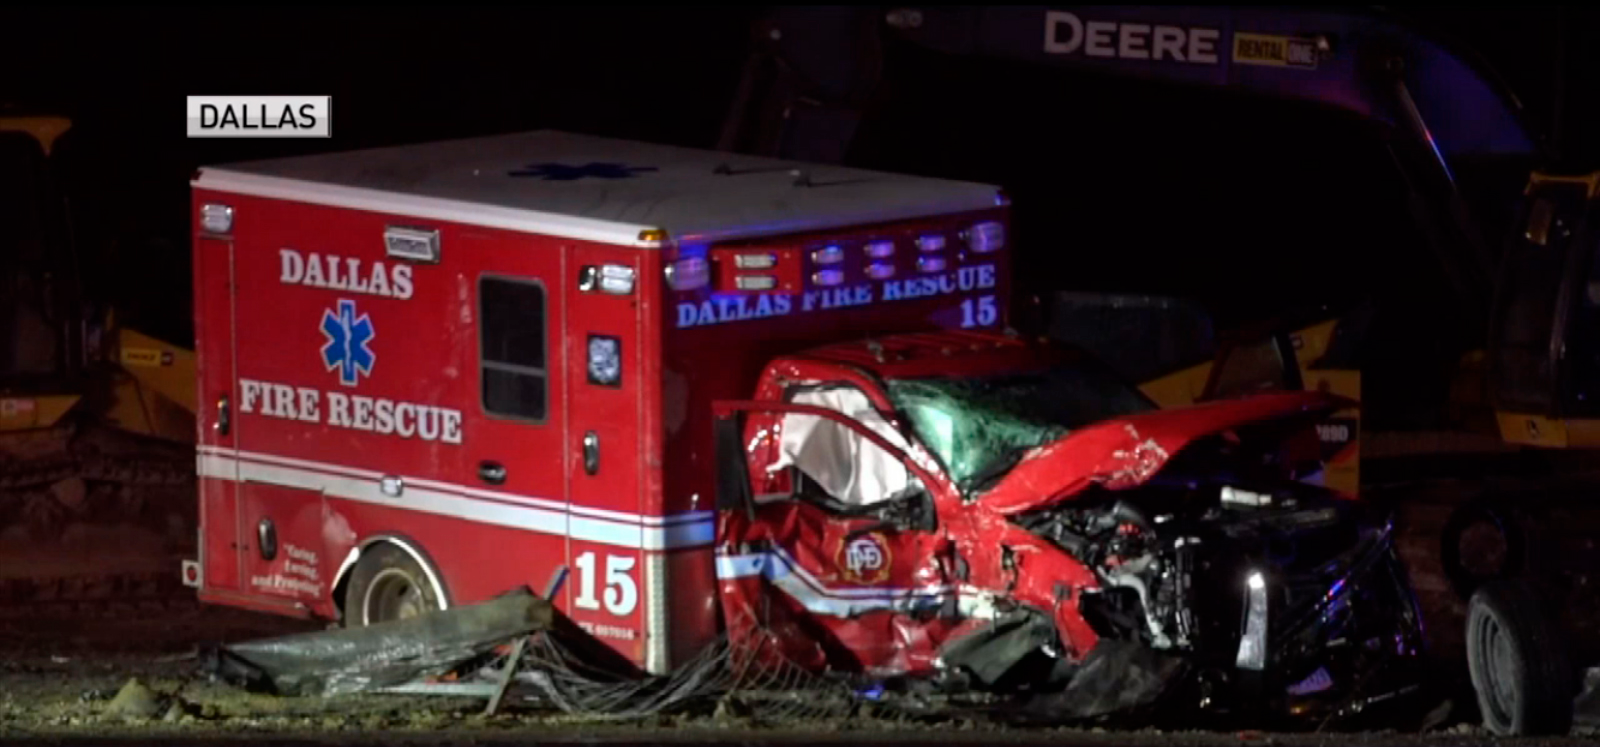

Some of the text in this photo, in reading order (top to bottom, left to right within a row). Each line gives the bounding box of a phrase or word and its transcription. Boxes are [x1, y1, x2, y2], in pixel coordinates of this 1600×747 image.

[1043, 10, 1220, 63] DEERE
[1237, 38, 1284, 60] RENTAL
[279, 248, 414, 300] DALLAS
[675, 263, 997, 329] DALLAS FIRE RESCUE
[959, 295, 998, 330] 15
[239, 378, 463, 445] FIRE RESCUE
[574, 550, 638, 617] 15
